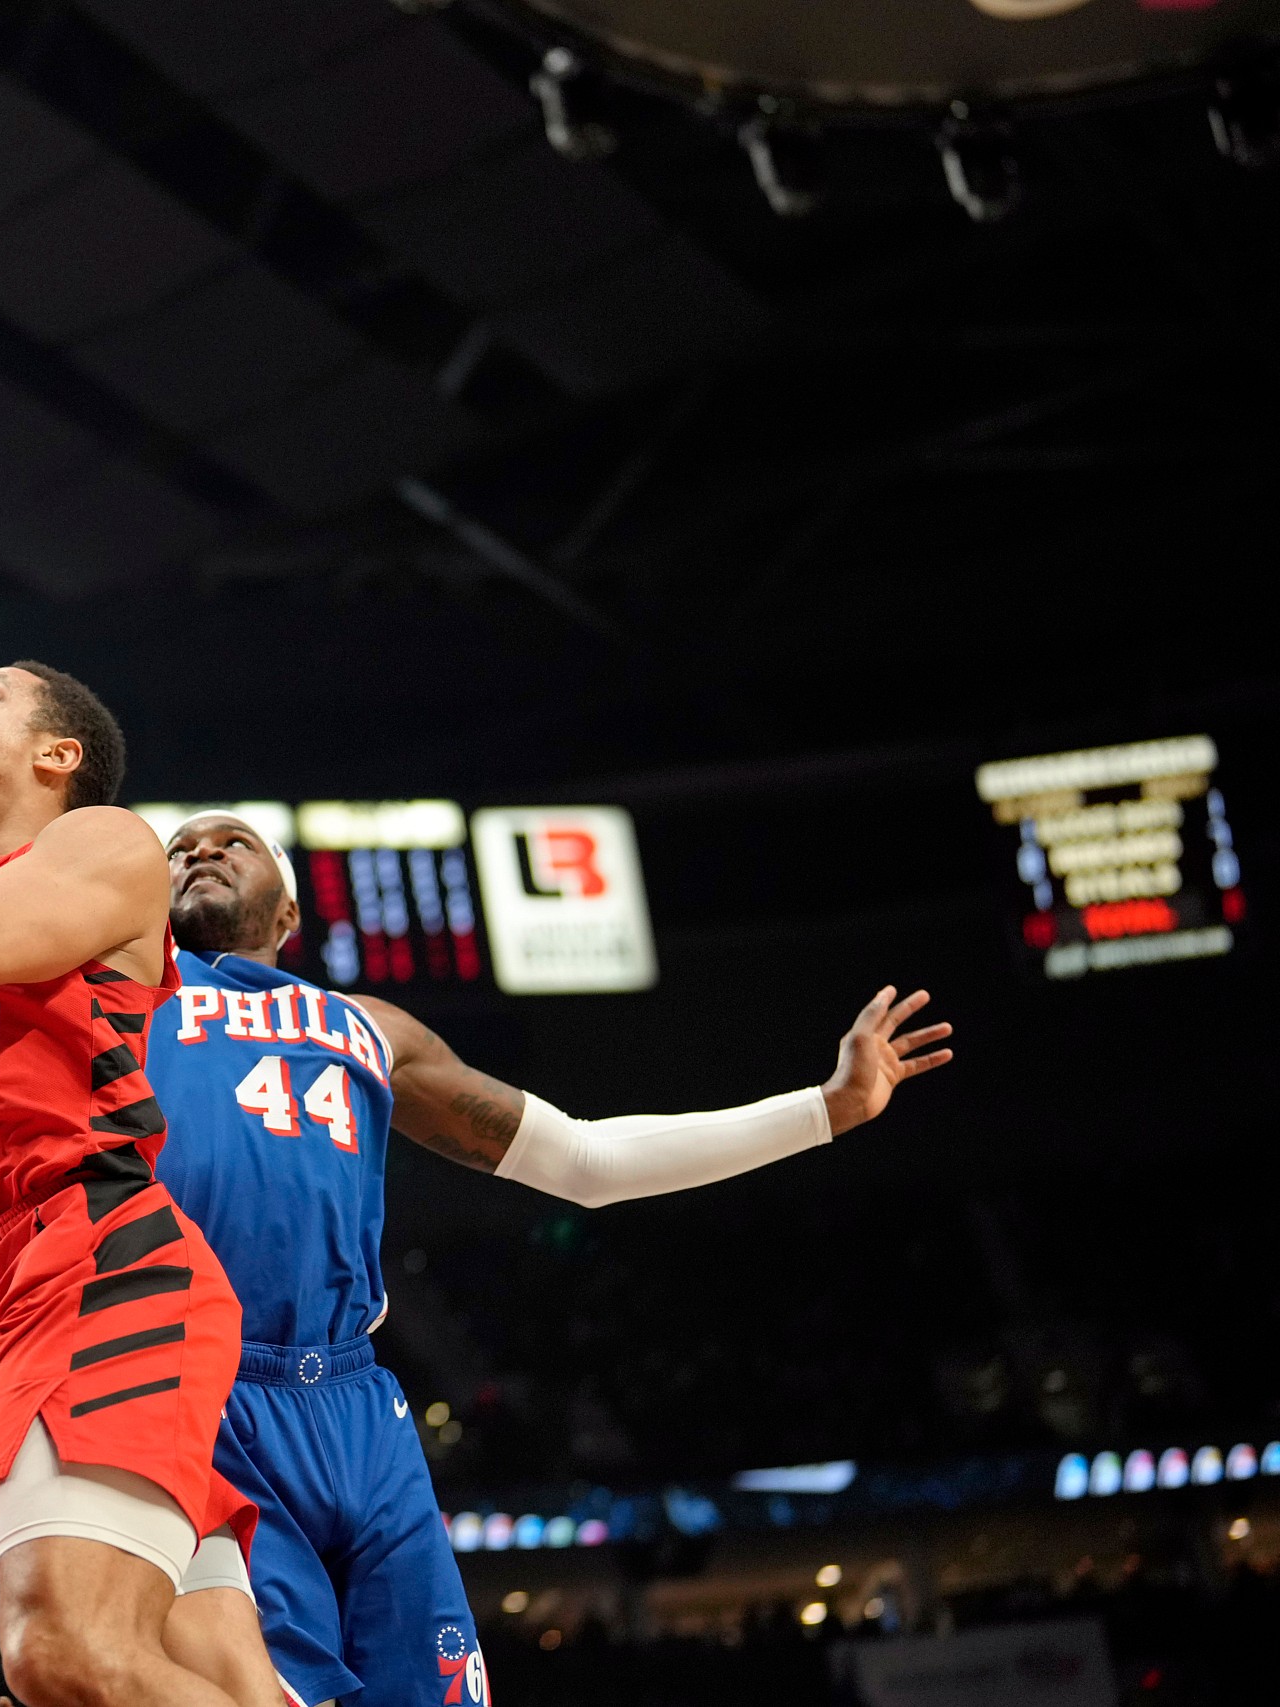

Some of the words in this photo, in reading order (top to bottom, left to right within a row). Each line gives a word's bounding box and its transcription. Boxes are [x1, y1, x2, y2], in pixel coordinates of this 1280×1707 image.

[176, 984, 388, 1088] PHILA
[235, 1056, 359, 1154] 44
[437, 1651, 482, 1705] 76
